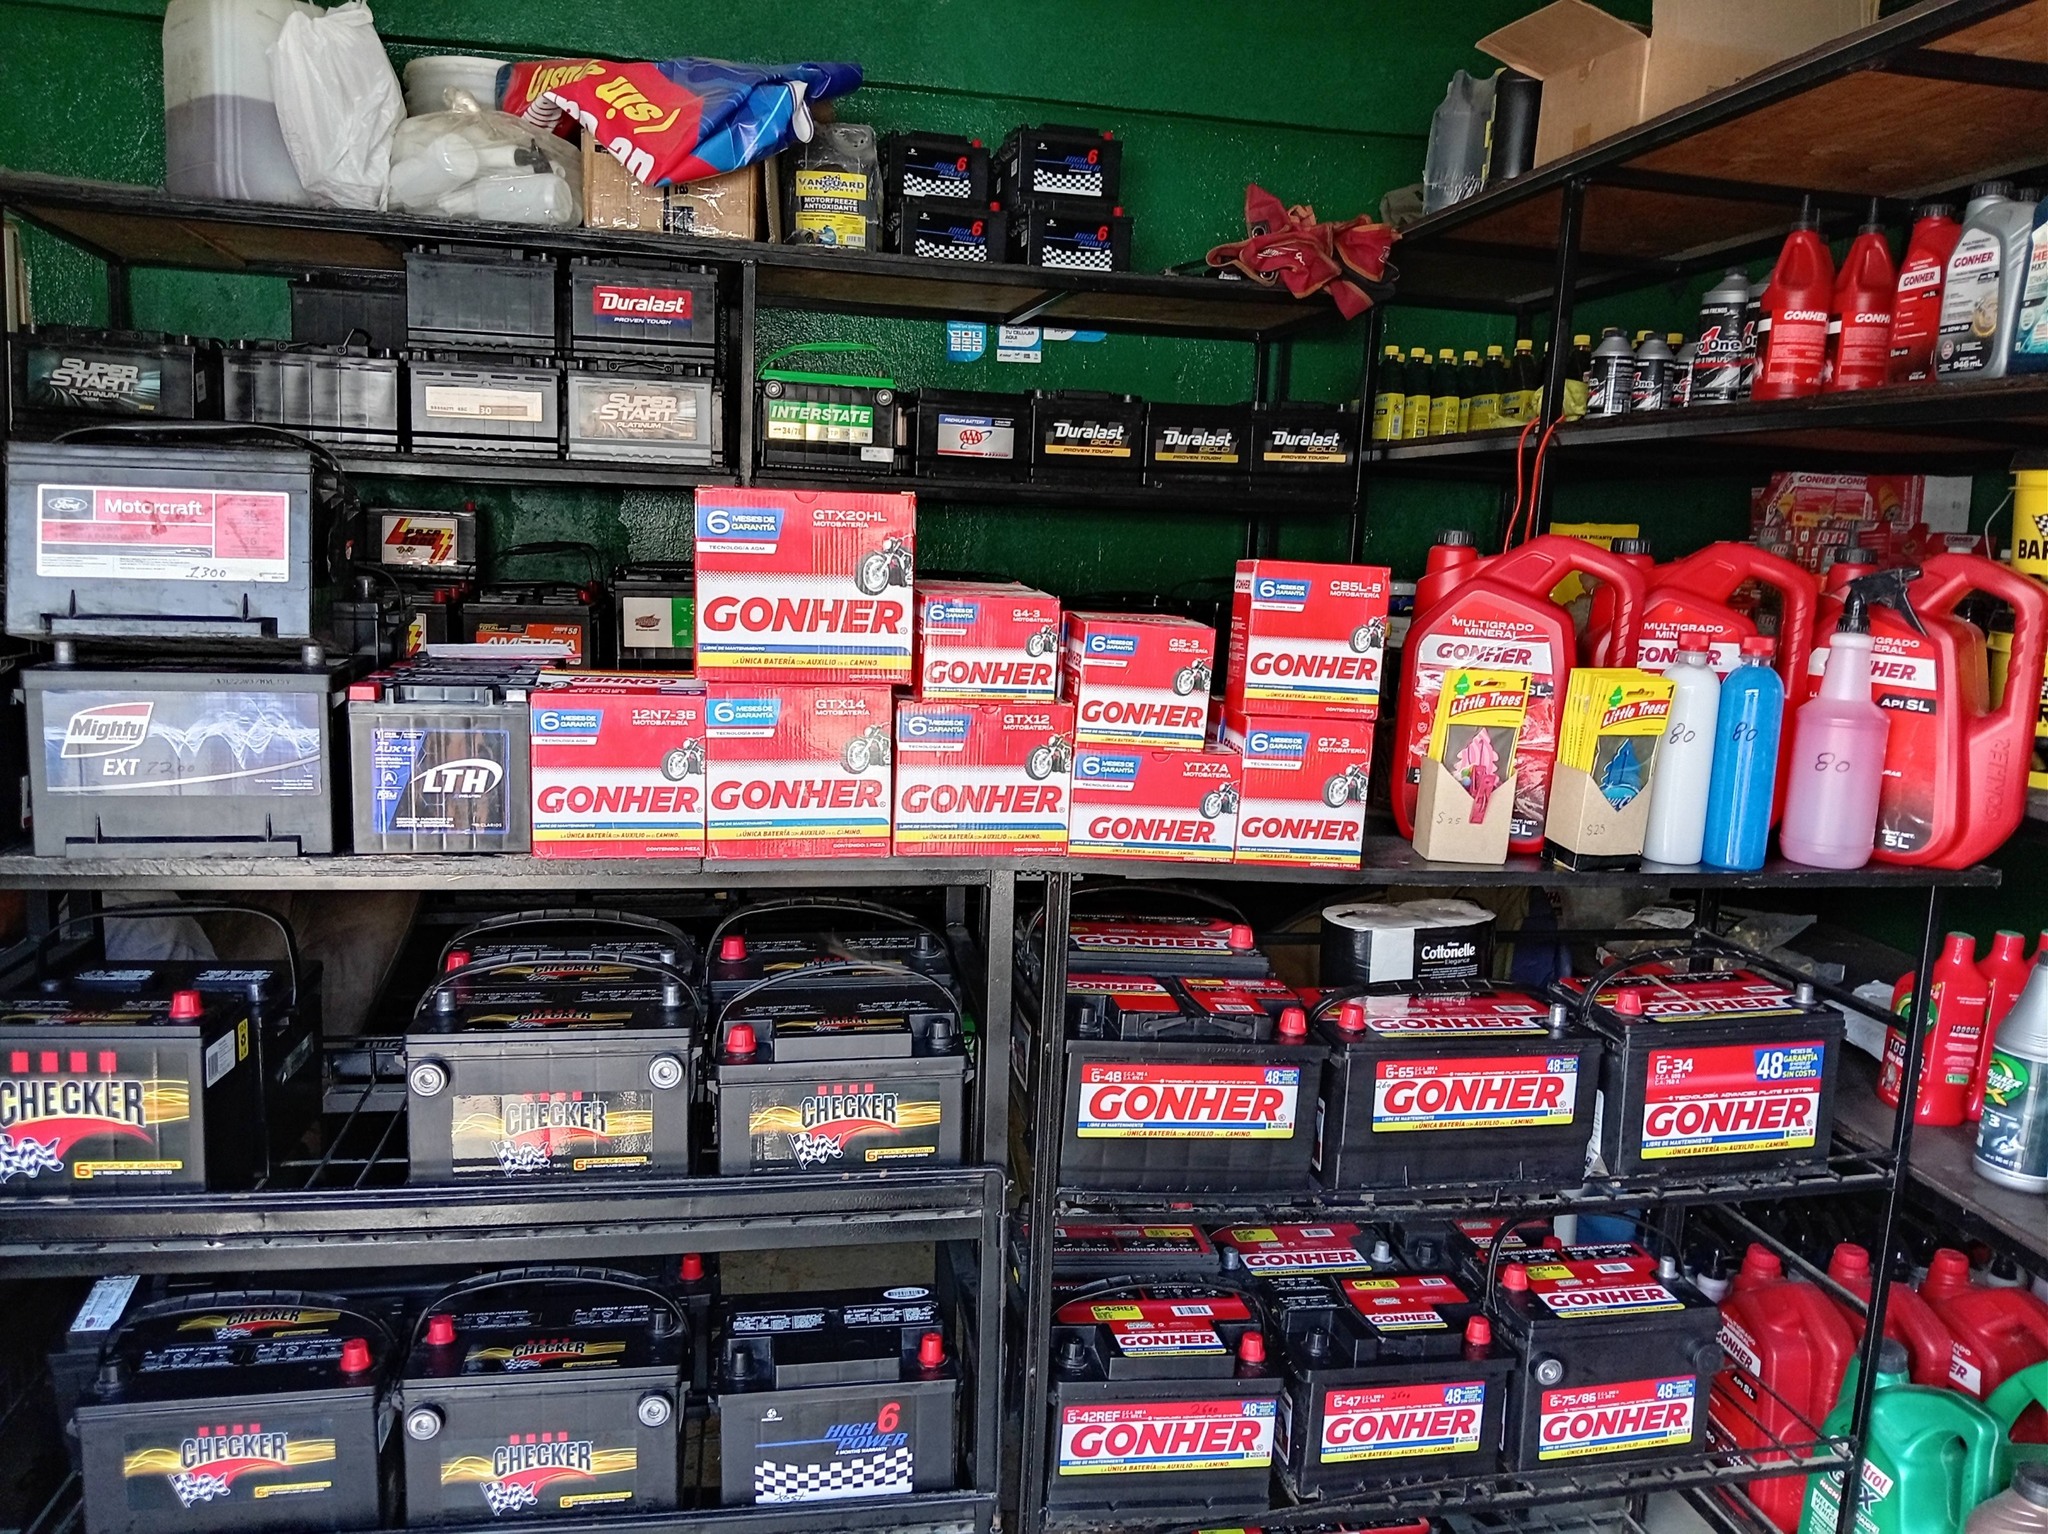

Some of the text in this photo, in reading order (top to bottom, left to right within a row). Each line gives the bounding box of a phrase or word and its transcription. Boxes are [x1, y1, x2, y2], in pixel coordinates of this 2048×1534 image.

[956, 157, 967, 171] 6
[1087, 149, 1098, 164] 6
[1069, 163, 1101, 171] POWER
[799, 178, 864, 189] VANGUARD
[804, 197, 857, 205] MOTORFREEZE
[804, 203, 857, 212] ANTIOXIDANTE
[948, 221, 983, 236] HIGH 6
[1097, 226, 1108, 241] 6
[953, 234, 986, 244] POWER
[1079, 240, 1111, 249] POWER
[1954, 252, 1994, 268] GONHER
[1903, 272, 1935, 286] GONHER
[599, 292, 684, 313] Duralast
[1709, 340, 1741, 350] One
[61, 358, 138, 378] SUPER
[51, 370, 138, 391] START
[68, 388, 120, 399] PLATINUM
[609, 393, 677, 408] SUPER
[480, 406, 492, 415] 30
[600, 407, 676, 421] START
[771, 405, 870, 423] INTERSTATE
[1053, 423, 1124, 440] Duralast
[1163, 430, 1232, 446] Duralast
[1272, 431, 1340, 447] Duralast
[1091, 438, 1122, 446] GOLD
[53, 499, 80, 510] Ford
[105, 498, 202, 514] Motorcraft
[706, 511, 730, 534] 6
[813, 510, 887, 522] GTX20HL
[813, 520, 869, 528] MOTOBATERÍA
[731, 522, 776, 532] GARANTÍA
[186, 566, 227, 578] 1300
[1330, 581, 1381, 591] CB5L-B
[703, 596, 903, 634] GONHER
[1013, 609, 1040, 617] G4-3
[1452, 616, 1534, 632] MULTIGRADO
[1464, 627, 1517, 639] MINERAL
[1169, 638, 1199, 648] G5-3
[740, 656, 836, 666] ÚNICA BATERÍA AUXILIO
[1436, 643, 1532, 665] GONHER
[925, 660, 1052, 685] GONHER
[1250, 652, 1378, 680] GONHER
[570, 678, 677, 686] GONHER
[815, 700, 865, 709] GTX14
[1451, 692, 1523, 715] Little Trees
[1881, 699, 1930, 712] API SL
[632, 710, 697, 720] 12N7-3B
[714, 702, 734, 722] 6
[1004, 715, 1049, 724] GTX12
[1082, 700, 1204, 728] GONHER
[1603, 702, 1668, 725] Little Trees
[541, 712, 559, 730] 6
[71, 718, 144, 741] Mighty
[1669, 722, 1696, 745] 80
[1732, 722, 1758, 742] 80
[1318, 738, 1350, 747] G7-3
[103, 759, 141, 776] EXT
[1184, 762, 1229, 772] YTX7A
[1815, 752, 1850, 772] 80
[423, 769, 489, 793] LTH
[537, 786, 699, 813] GONHER
[711, 780, 882, 810] GONHER
[902, 784, 1062, 813] GONHER
[1088, 816, 1215, 843] GONHER
[1242, 817, 1359, 841] GONHER
[1884, 836, 1910, 850] 5L
[1077, 935, 1219, 949] GONHER
[1422, 943, 1475, 960] Cottonelle
[1445, 957, 1470, 965] Elegance
[1372, 1018, 1526, 1030] GONHER
[1783, 1053, 1818, 1062] GARANTÍA
[1385, 1059, 1561, 1079] G-65 48
[1656, 1058, 1693, 1074] G-34
[1756, 1052, 1783, 1080] 48
[1782, 1069, 1816, 1078] SIN COSTO
[1091, 1071, 1279, 1084] G-48 48
[1987, 1068, 2023, 1089] QUAKER
[1988, 1079, 2013, 1092] STATE
[0, 1080, 146, 1127] CHECKER
[1089, 1086, 1284, 1121] GONHER
[1384, 1077, 1565, 1114] GONHER
[1674, 1092, 1719, 1102] TECNOLOGÍA
[1721, 1090, 1757, 1098] ADVANCED
[505, 1101, 608, 1135] CHECKER
[802, 1094, 898, 1128] CHECKER
[1646, 1097, 1812, 1137] GONHER
[1670, 1137, 1712, 1146] MANTENIMIENTO
[1672, 1145, 1692, 1155] ÚNICA
[1693, 1144, 1720, 1154] BATERÍA
[1246, 1252, 1358, 1266] GONHER
[1547, 1288, 1666, 1307] GONHER
[226, 1309, 301, 1326] CHECKER
[1371, 1314, 1438, 1323] GONHER
[1120, 1335, 1215, 1345] GONHER
[512, 1342, 586, 1357] CHECKER
[1334, 1389, 1462, 1408] G-47 48
[1550, 1383, 1674, 1408] G-75/86 48
[825, 1402, 902, 1439] HIGH 6
[1067, 1403, 1257, 1423] G-42REF 48
[1326, 1409, 1476, 1445] GONHER
[1543, 1402, 1687, 1442] GONHER
[838, 1432, 909, 1450] POWER
[1071, 1420, 1261, 1458] GONHER
[180, 1432, 287, 1468] CHECKER
[862, 1447, 887, 1455] WARRANTY
[493, 1441, 592, 1478] CHECKER
